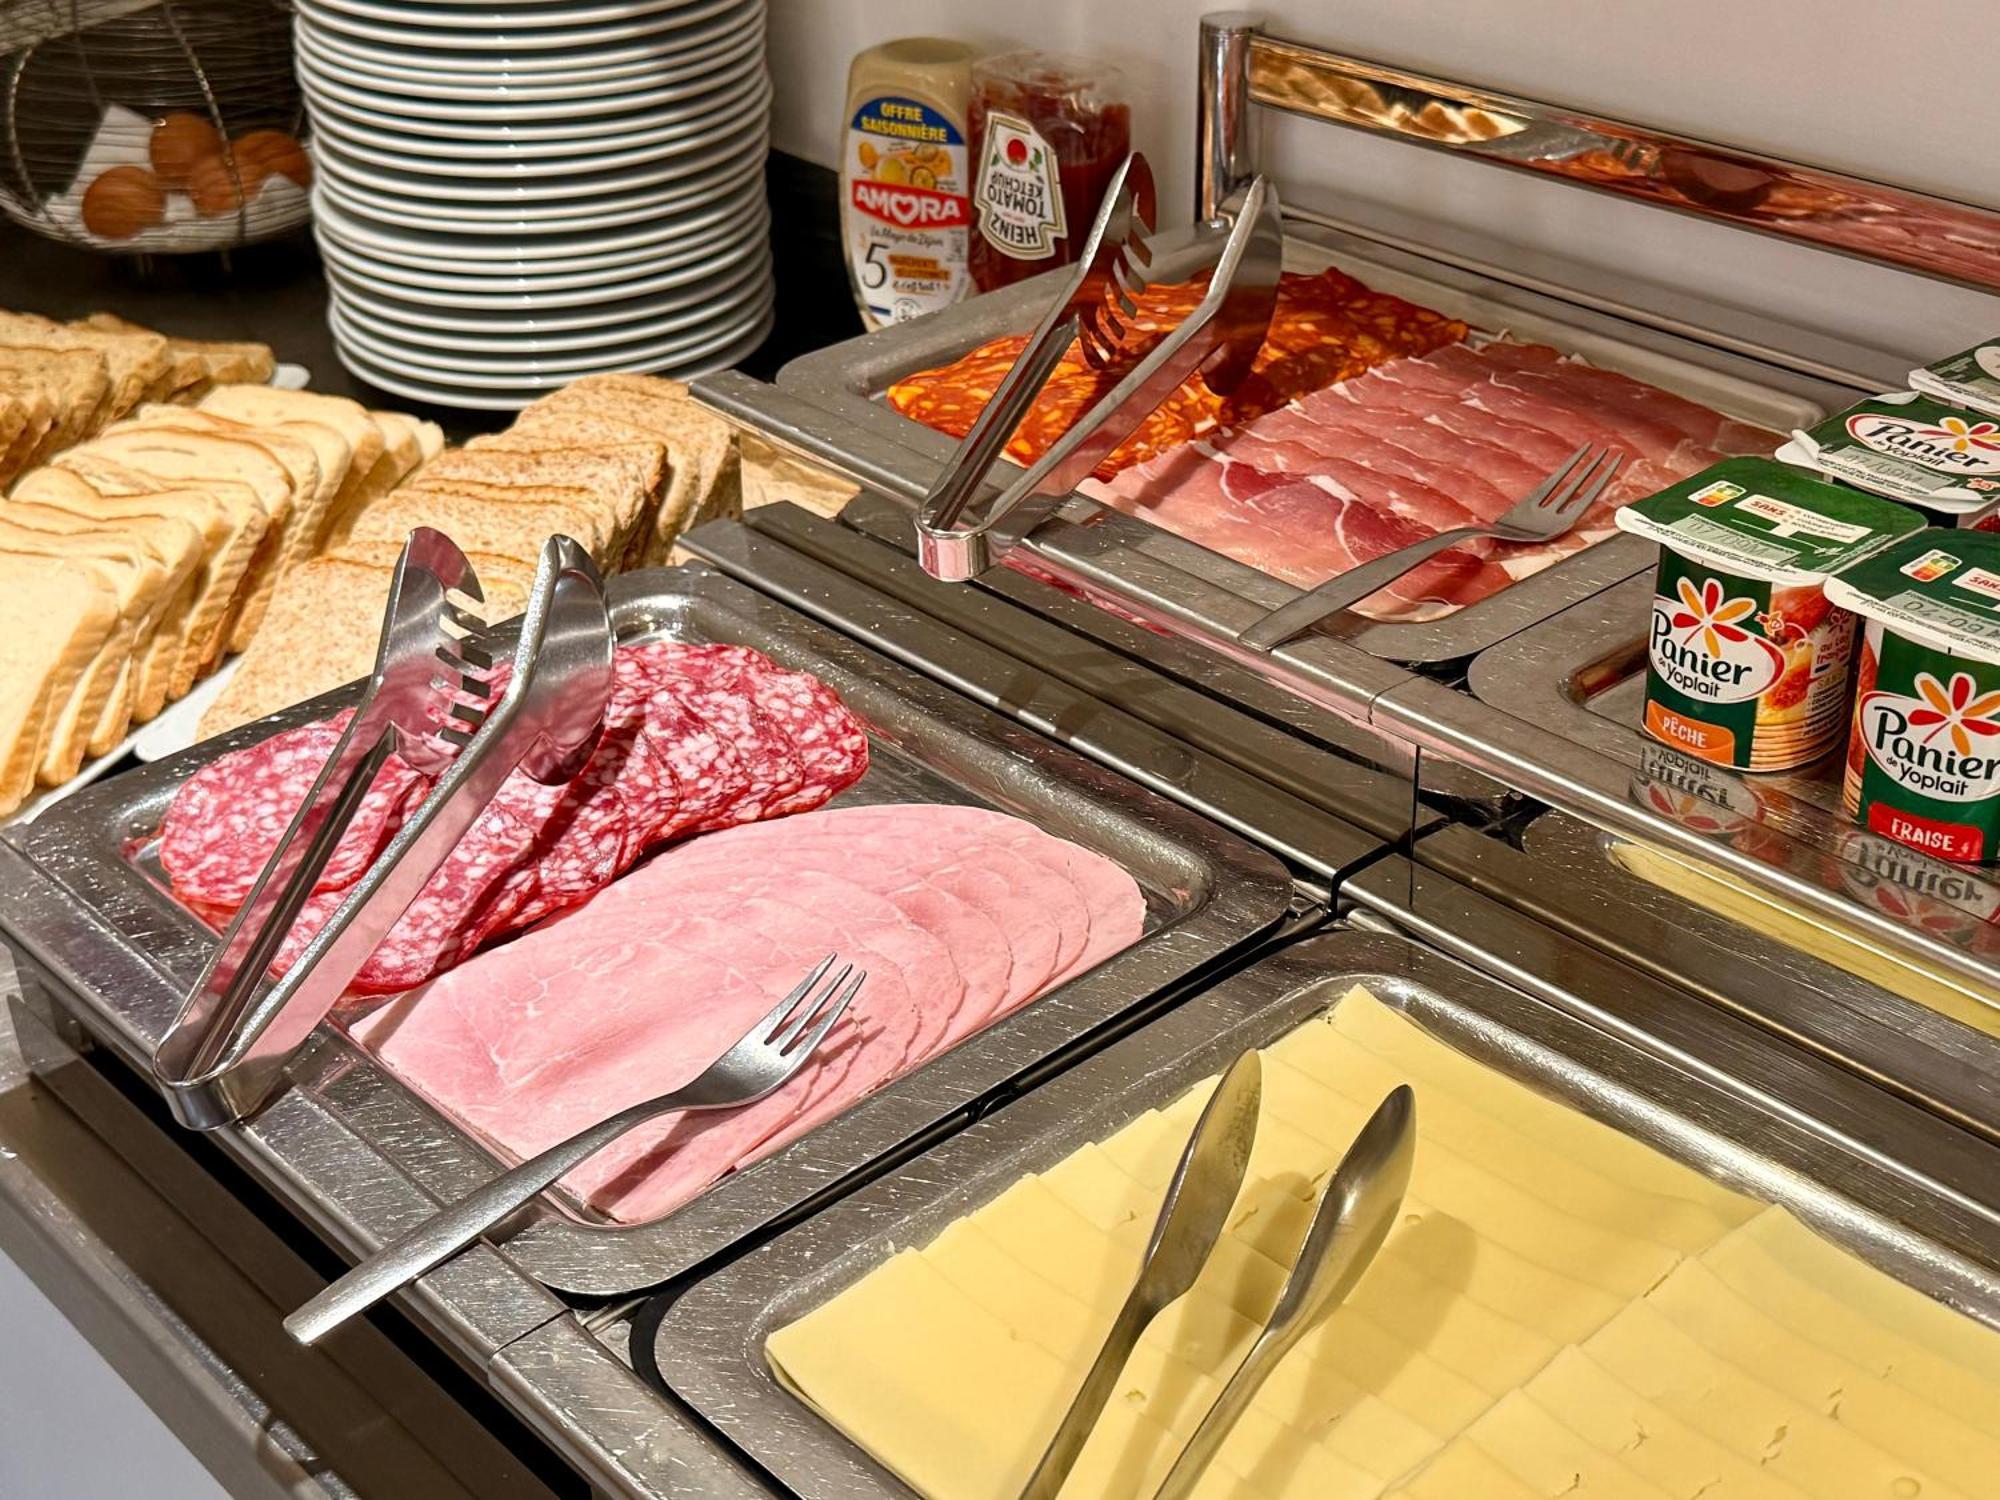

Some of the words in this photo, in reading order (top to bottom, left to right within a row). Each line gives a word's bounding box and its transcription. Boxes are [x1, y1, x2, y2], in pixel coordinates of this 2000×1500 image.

[881, 102, 923, 121] OFFRE
[861, 117, 948, 142] SAISONNIÈRE
[991, 171, 1044, 199] KETCHUP
[856, 185, 962, 224] AMORA
[988, 184, 1047, 219] TOMATO
[991, 213, 1038, 244] HEINZ
[862, 243, 890, 289] 5
[1865, 421, 1989, 467] Panier
[1750, 500, 1787, 517] SANS
[1652, 608, 1752, 685] Panier
[1663, 716, 1708, 748] PÊCHE
[1874, 706, 2000, 780] Panier
[1886, 756, 1898, 767] de
[1891, 818, 1955, 851] FRAISE
